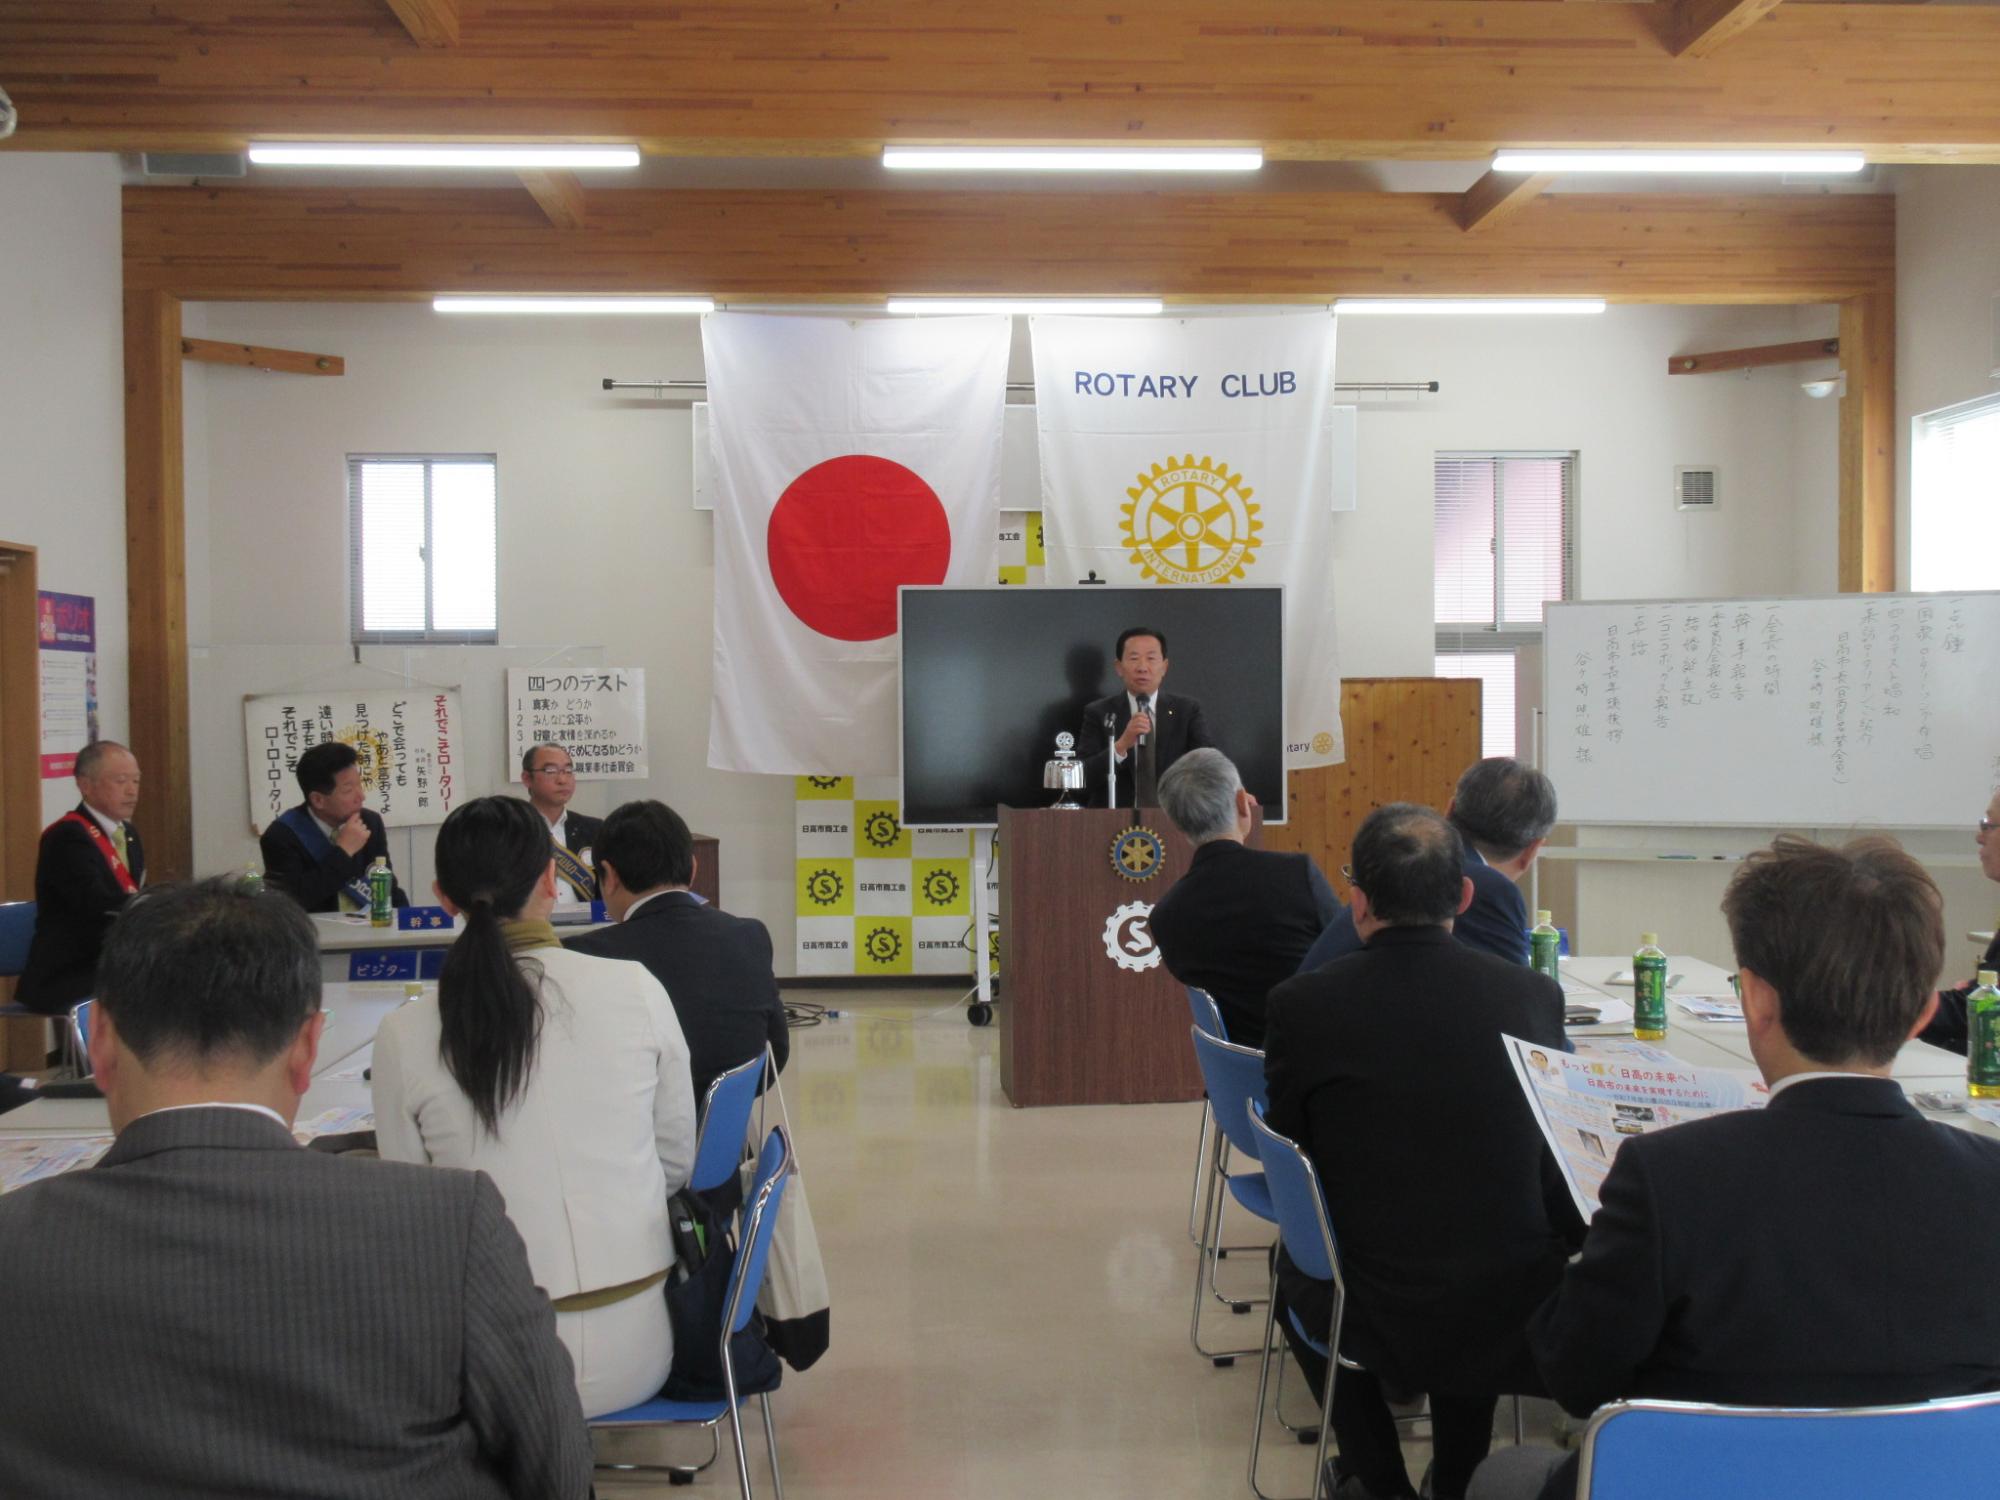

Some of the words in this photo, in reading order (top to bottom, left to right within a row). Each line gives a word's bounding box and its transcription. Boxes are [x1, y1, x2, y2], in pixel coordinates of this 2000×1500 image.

[1075, 371, 1198, 398] ROTARY
[1221, 371, 1297, 398] CLUB
[1160, 470, 1218, 488] ROTARY
[1142, 549, 1243, 584] INTERNATIONAL
[528, 674, 628, 692] 四つのテスト
[517, 699, 522, 711] 1
[517, 714, 524, 726] 2
[533, 714, 592, 726] みんなに公平か
[281, 706, 298, 774] それでこそ
[301, 719, 316, 752] 手を
[517, 730, 524, 741] 3
[392, 701, 408, 787] どこで会っても
[1286, 742, 1311, 753] tary
[434, 695, 452, 812] それでこそロータリー
[802, 825, 848, 833] 日高市商工会
[860, 883, 906, 892] 日高市商工会
[802, 942, 848, 950] 日高市商工会
[357, 963, 407, 976] ビジター
